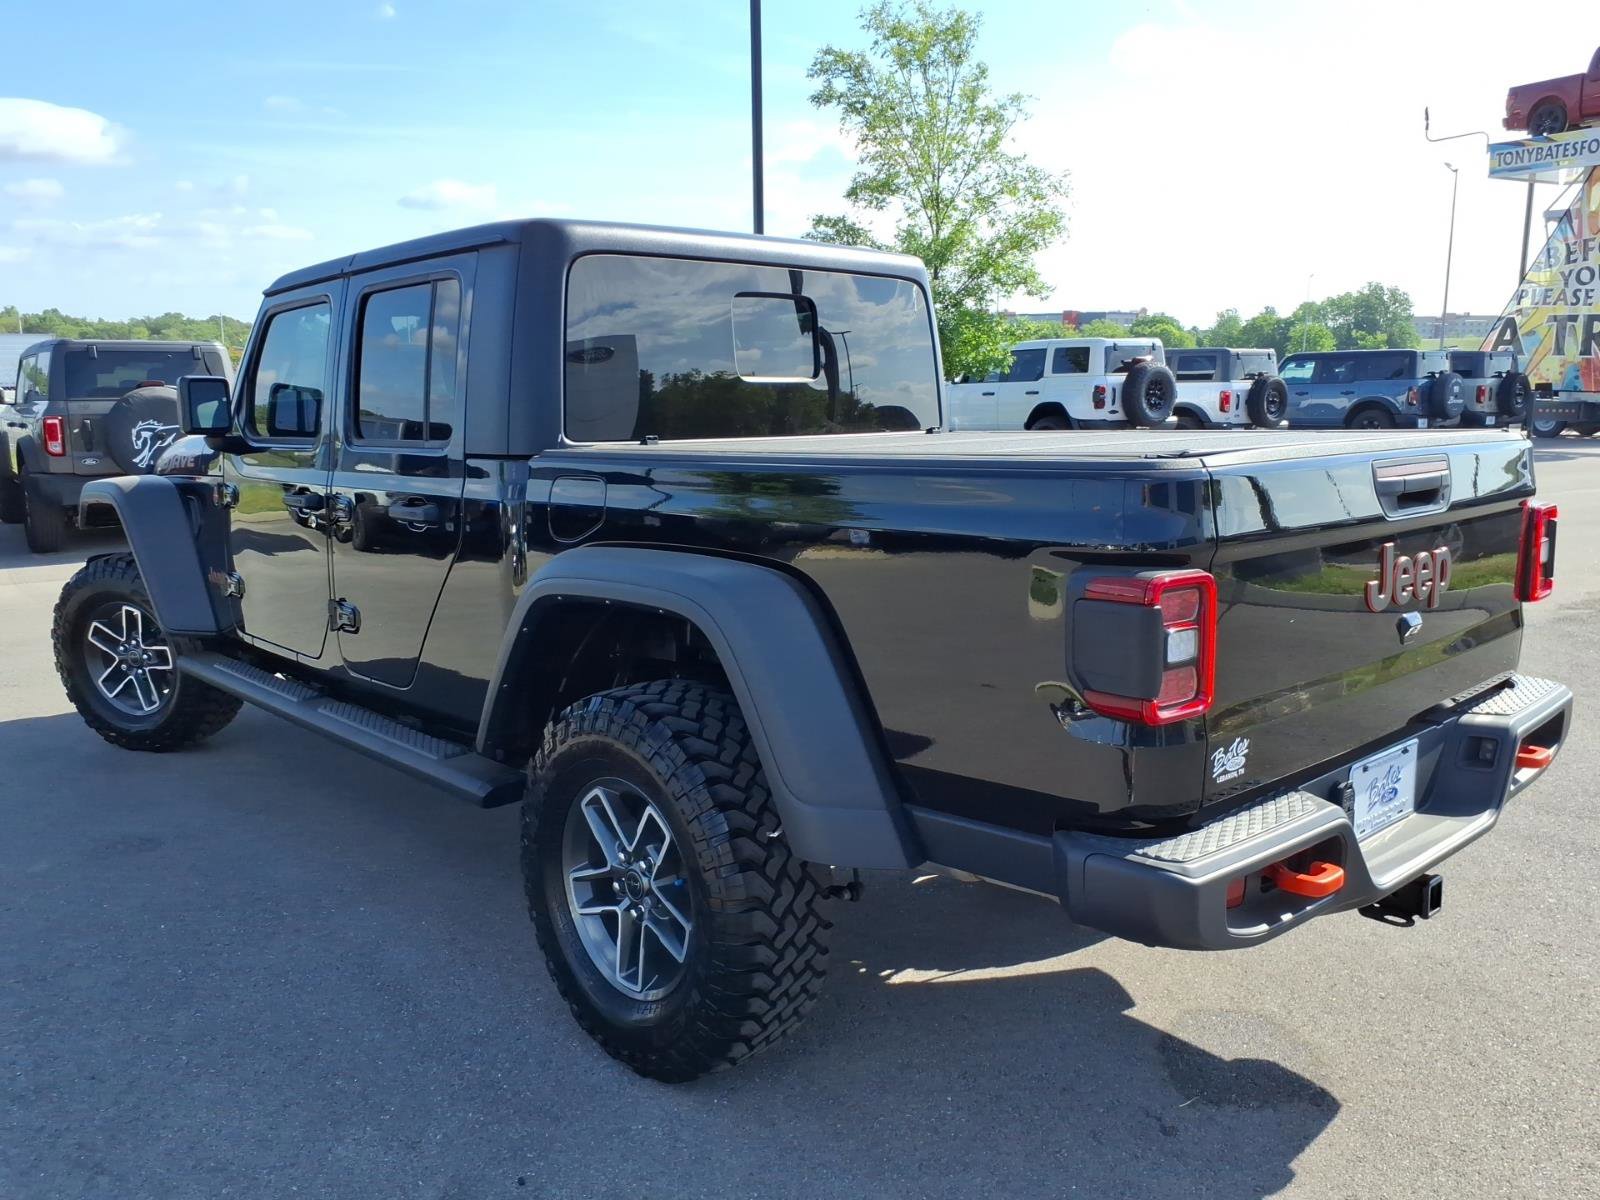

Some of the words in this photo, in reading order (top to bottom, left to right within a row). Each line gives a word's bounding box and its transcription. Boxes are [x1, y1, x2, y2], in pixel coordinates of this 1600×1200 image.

[1496, 138, 1600, 167] TONYBATESFO
[1544, 237, 1600, 269] BEF
[1559, 263, 1600, 288] YO
[1516, 288, 1595, 307] PLEASE
[1364, 542, 1452, 613] Jeep
